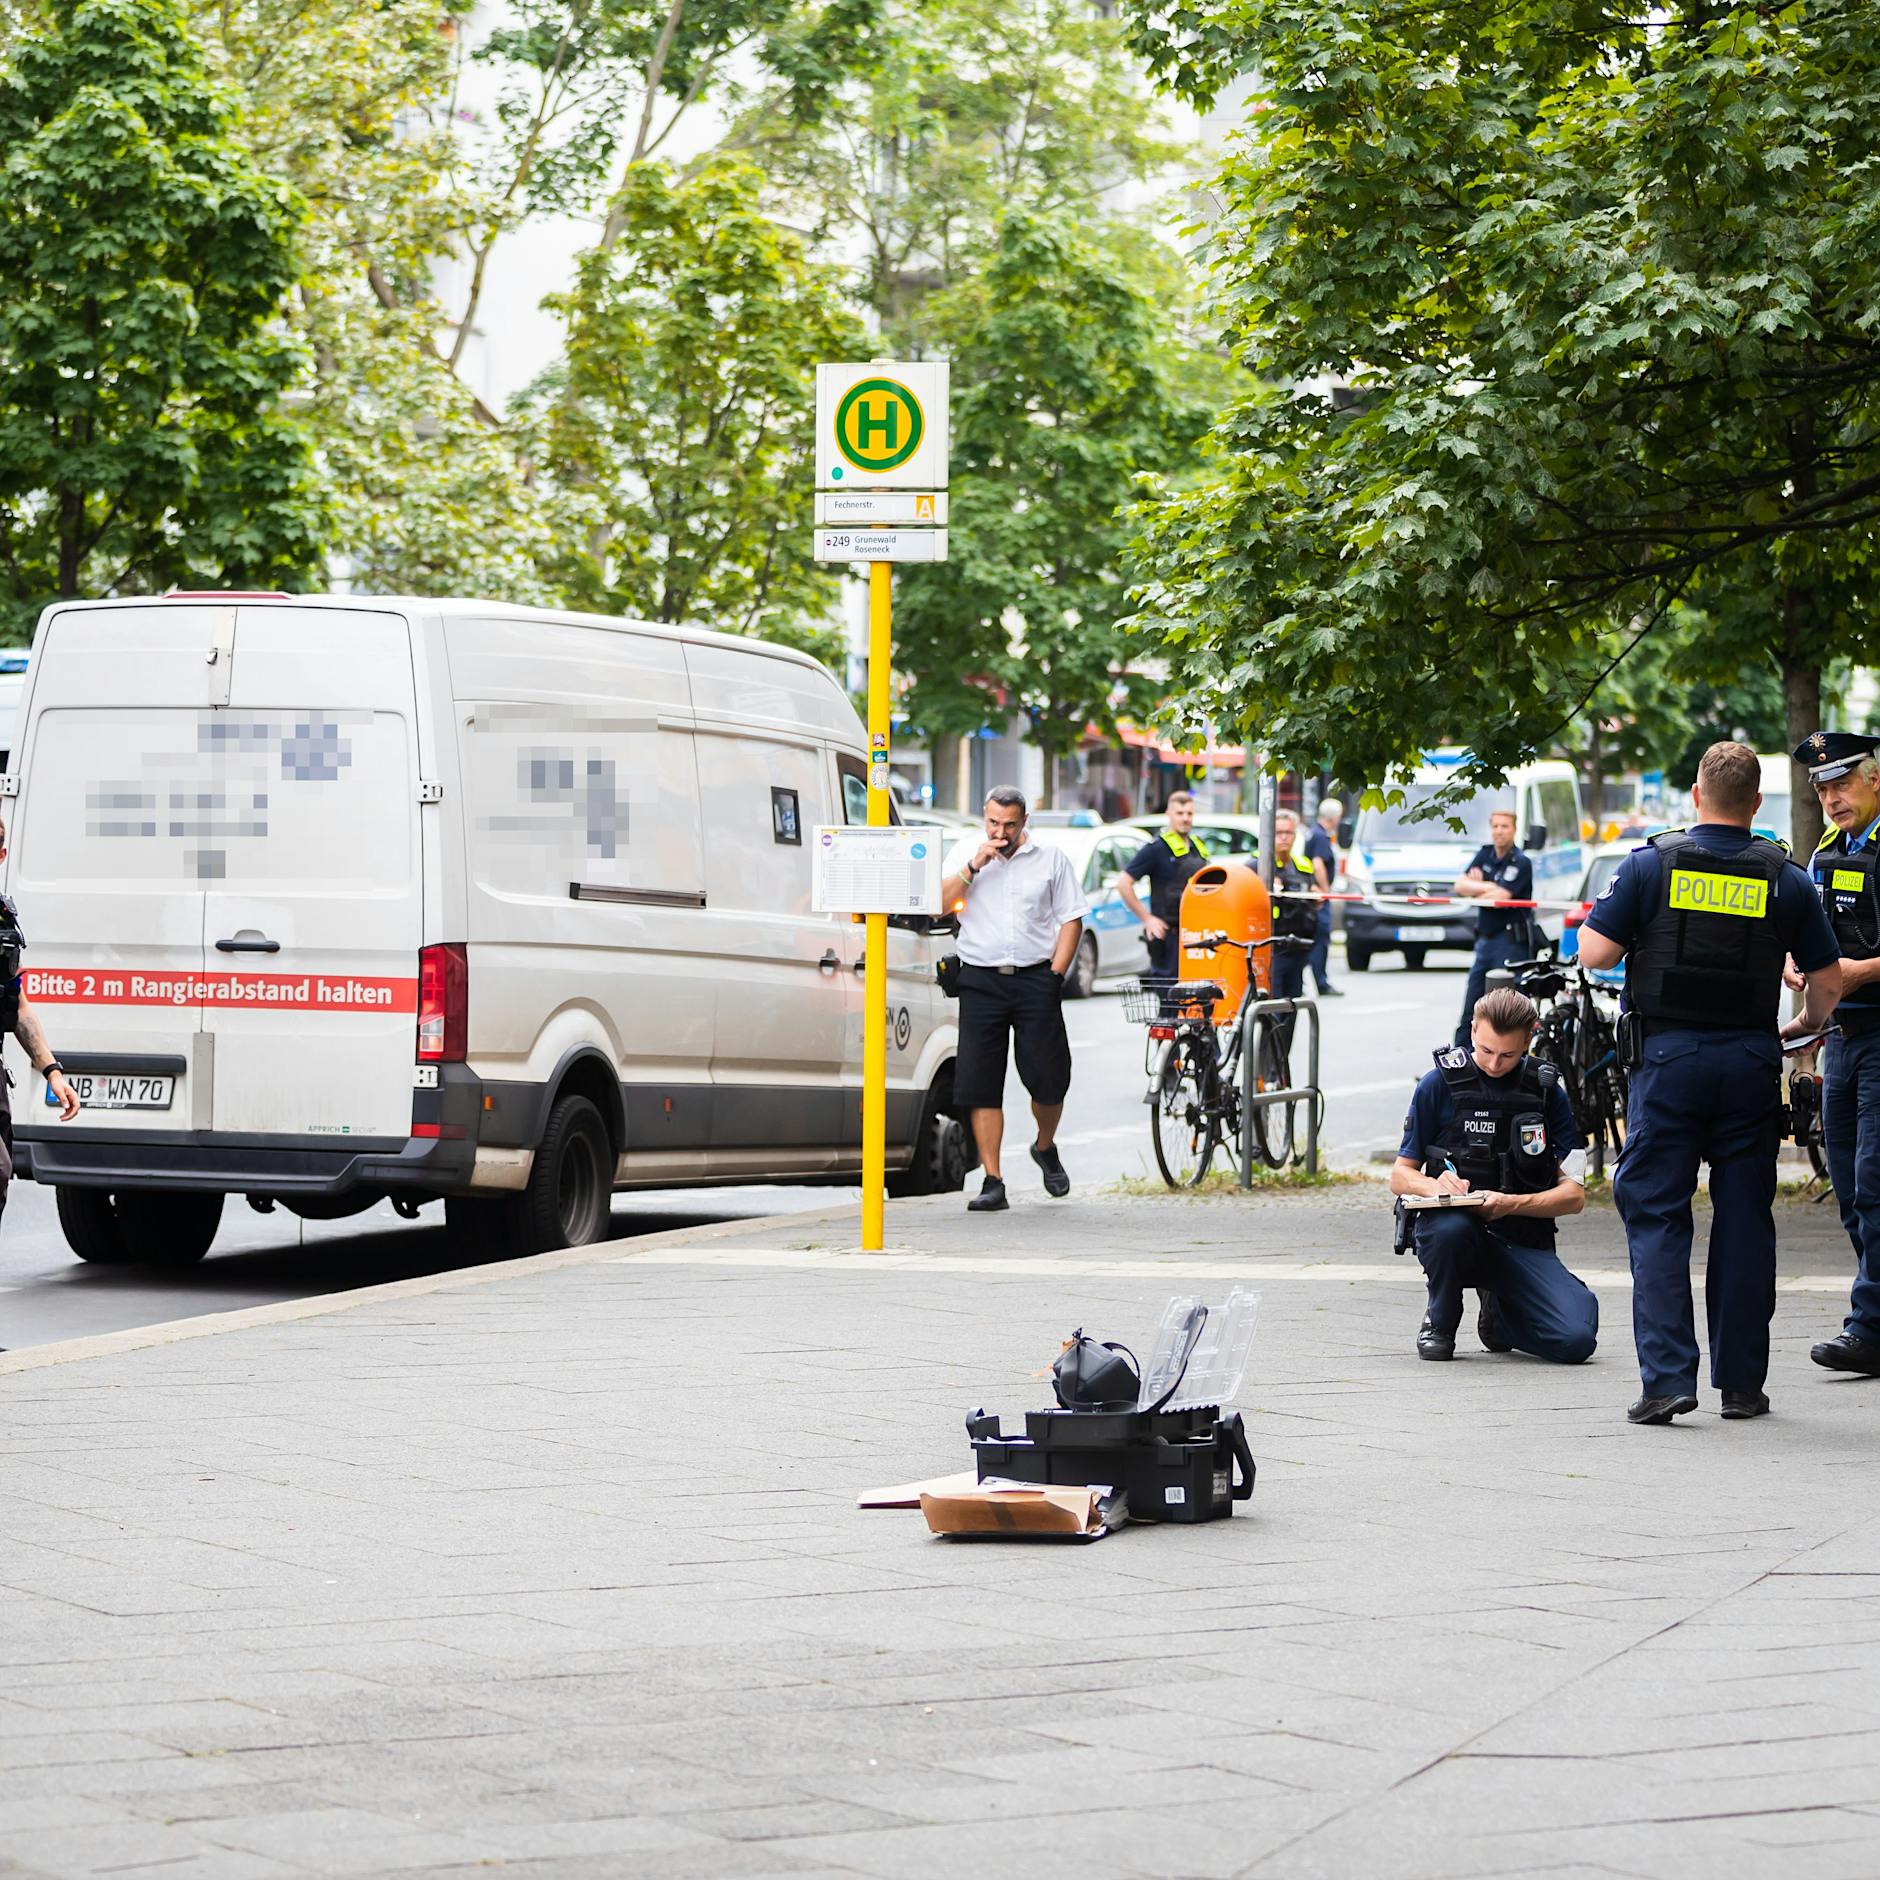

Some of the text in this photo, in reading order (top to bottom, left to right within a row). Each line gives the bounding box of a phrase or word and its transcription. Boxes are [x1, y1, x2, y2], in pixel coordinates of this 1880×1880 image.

[858, 401, 897, 449] H
[834, 500, 876, 509] Fechnerstr.
[917, 498, 935, 519] A
[832, 535, 897, 547] 249 Grunewald
[854, 545, 890, 553] Roseneck
[1835, 874, 1862, 888] POLIZEI
[1676, 876, 1762, 911] POLIZEI
[27, 974, 392, 1004] Bitte 2 m Rangierabstand halten
[68, 1077, 163, 1101] NB WN 70
[1464, 1120, 1495, 1134] POLIZEI
